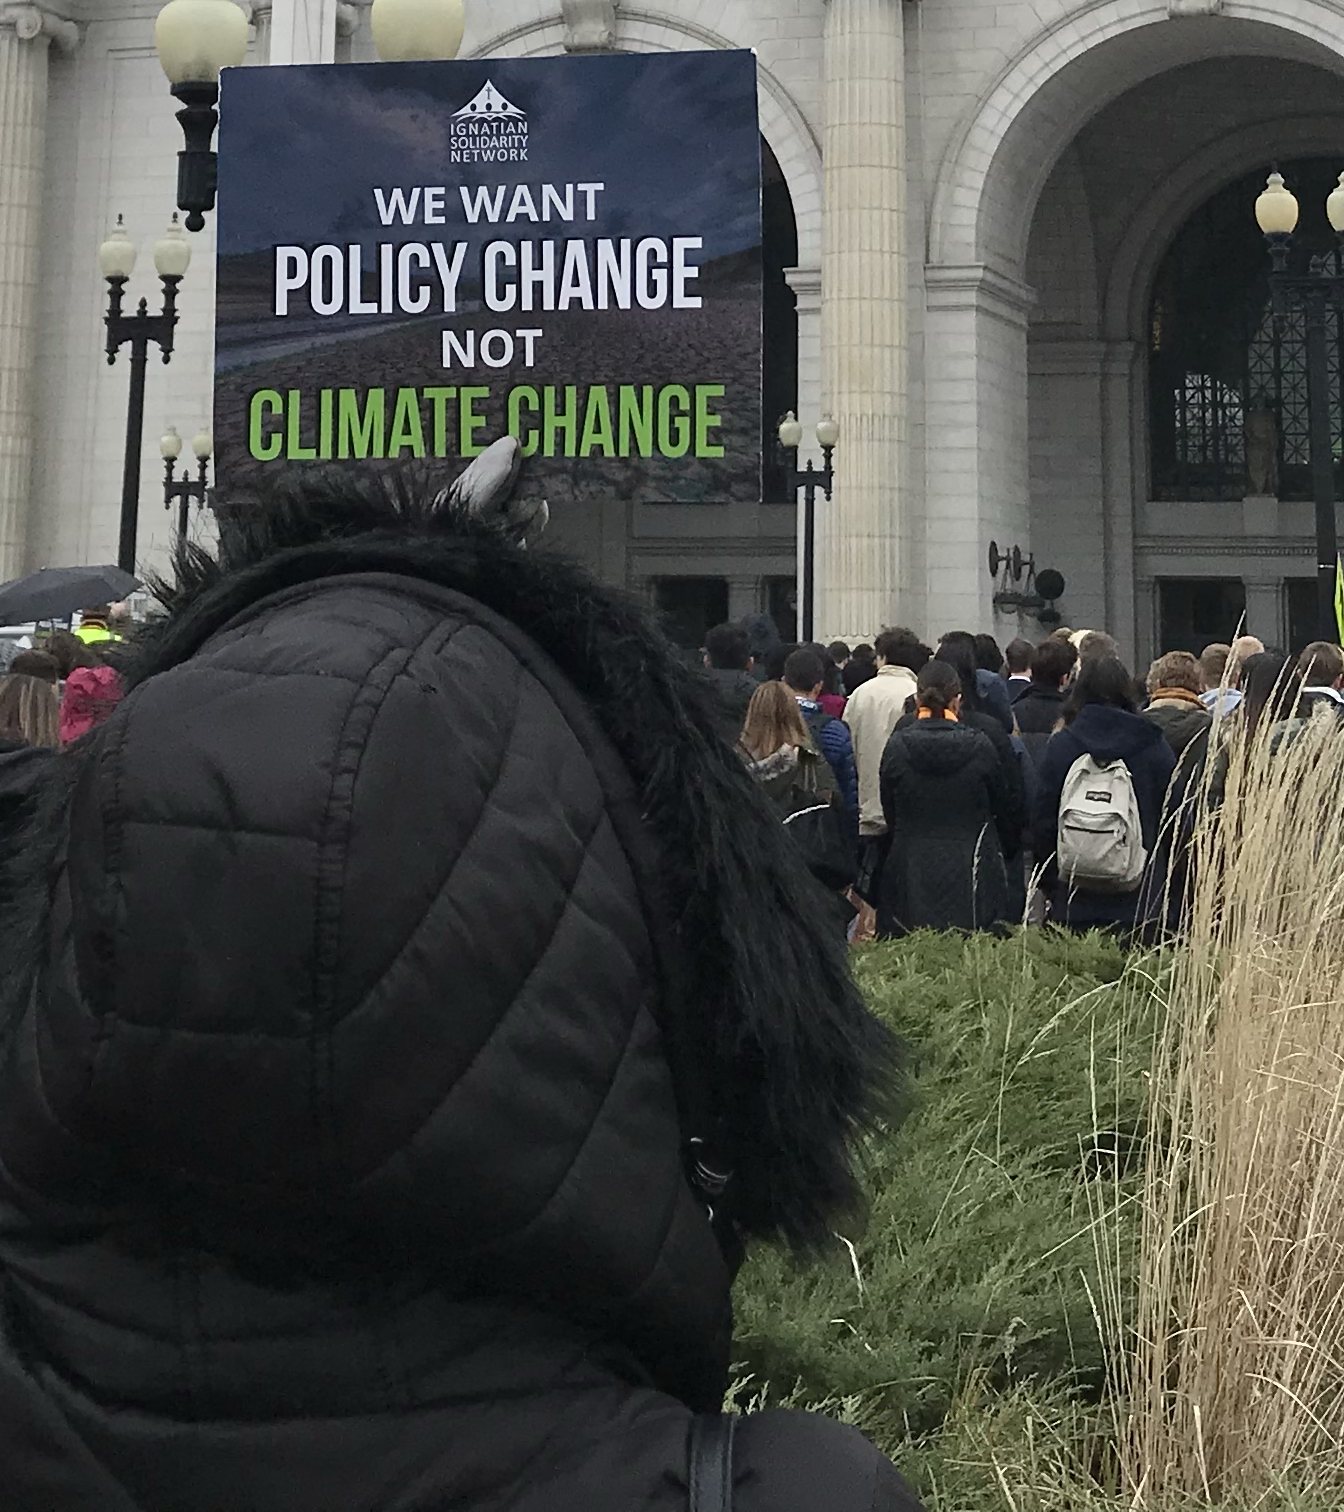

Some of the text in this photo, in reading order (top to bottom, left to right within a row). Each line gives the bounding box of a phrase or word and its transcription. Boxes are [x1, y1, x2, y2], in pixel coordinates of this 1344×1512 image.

[450, 122, 528, 136] IGNATIAN
[450, 135, 529, 149] SOLIDARITY
[450, 149, 528, 162] NETWORK
[373, 182, 605, 225] WE WANT
[274, 236, 704, 316] POLICY CHANGE
[441, 328, 544, 368] NOT
[249, 384, 726, 461] CLIMATE CHANGE
